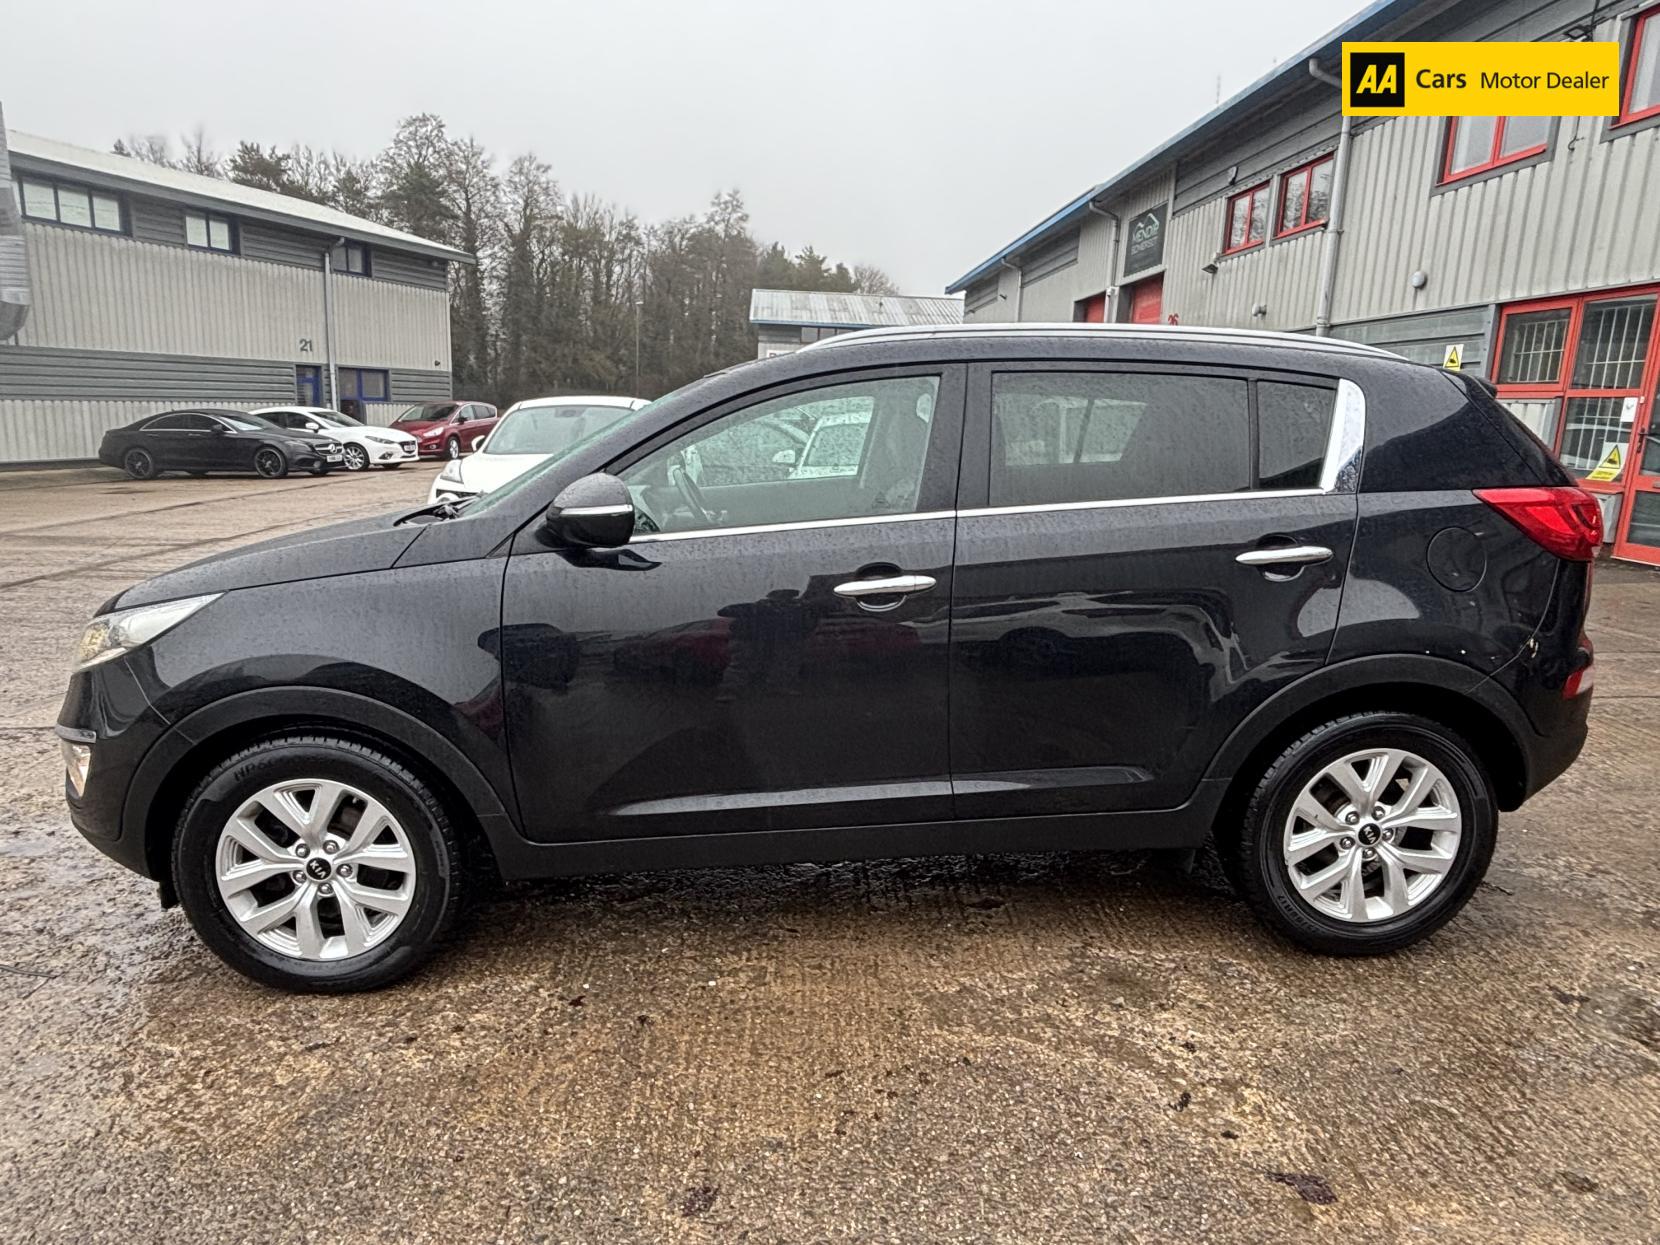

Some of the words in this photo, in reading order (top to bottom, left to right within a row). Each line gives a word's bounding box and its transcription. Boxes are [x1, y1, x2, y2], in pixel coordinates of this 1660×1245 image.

[299, 339, 313, 352] 21
[1363, 826, 1376, 844] KIA
[310, 860, 326, 878] KIA
